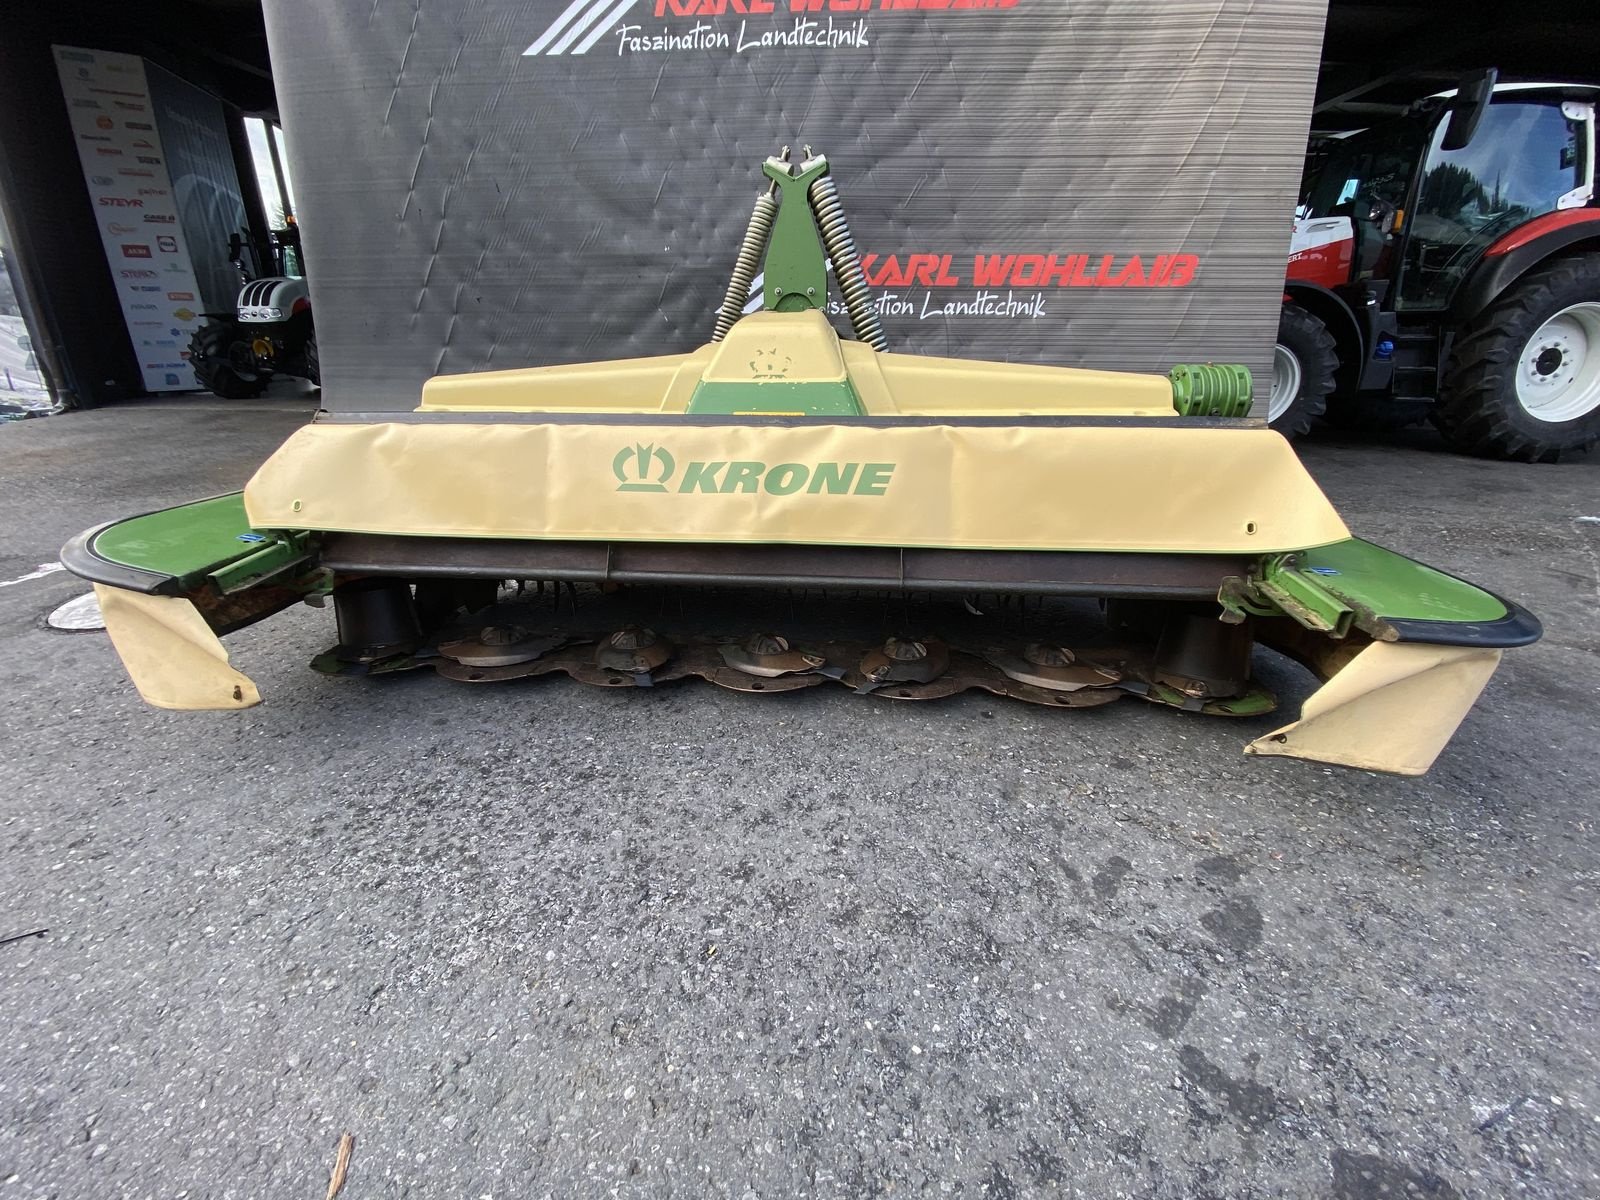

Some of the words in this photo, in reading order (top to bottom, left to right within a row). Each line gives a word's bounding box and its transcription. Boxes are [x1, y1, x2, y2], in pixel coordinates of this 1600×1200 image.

[616, 21, 730, 56] Faszination
[736, 17, 869, 53] Landtechnik
[99, 197, 144, 208] STEYR
[857, 254, 960, 287] KARL
[919, 289, 1047, 320] Landtechnik
[677, 461, 897, 496] KRONE
